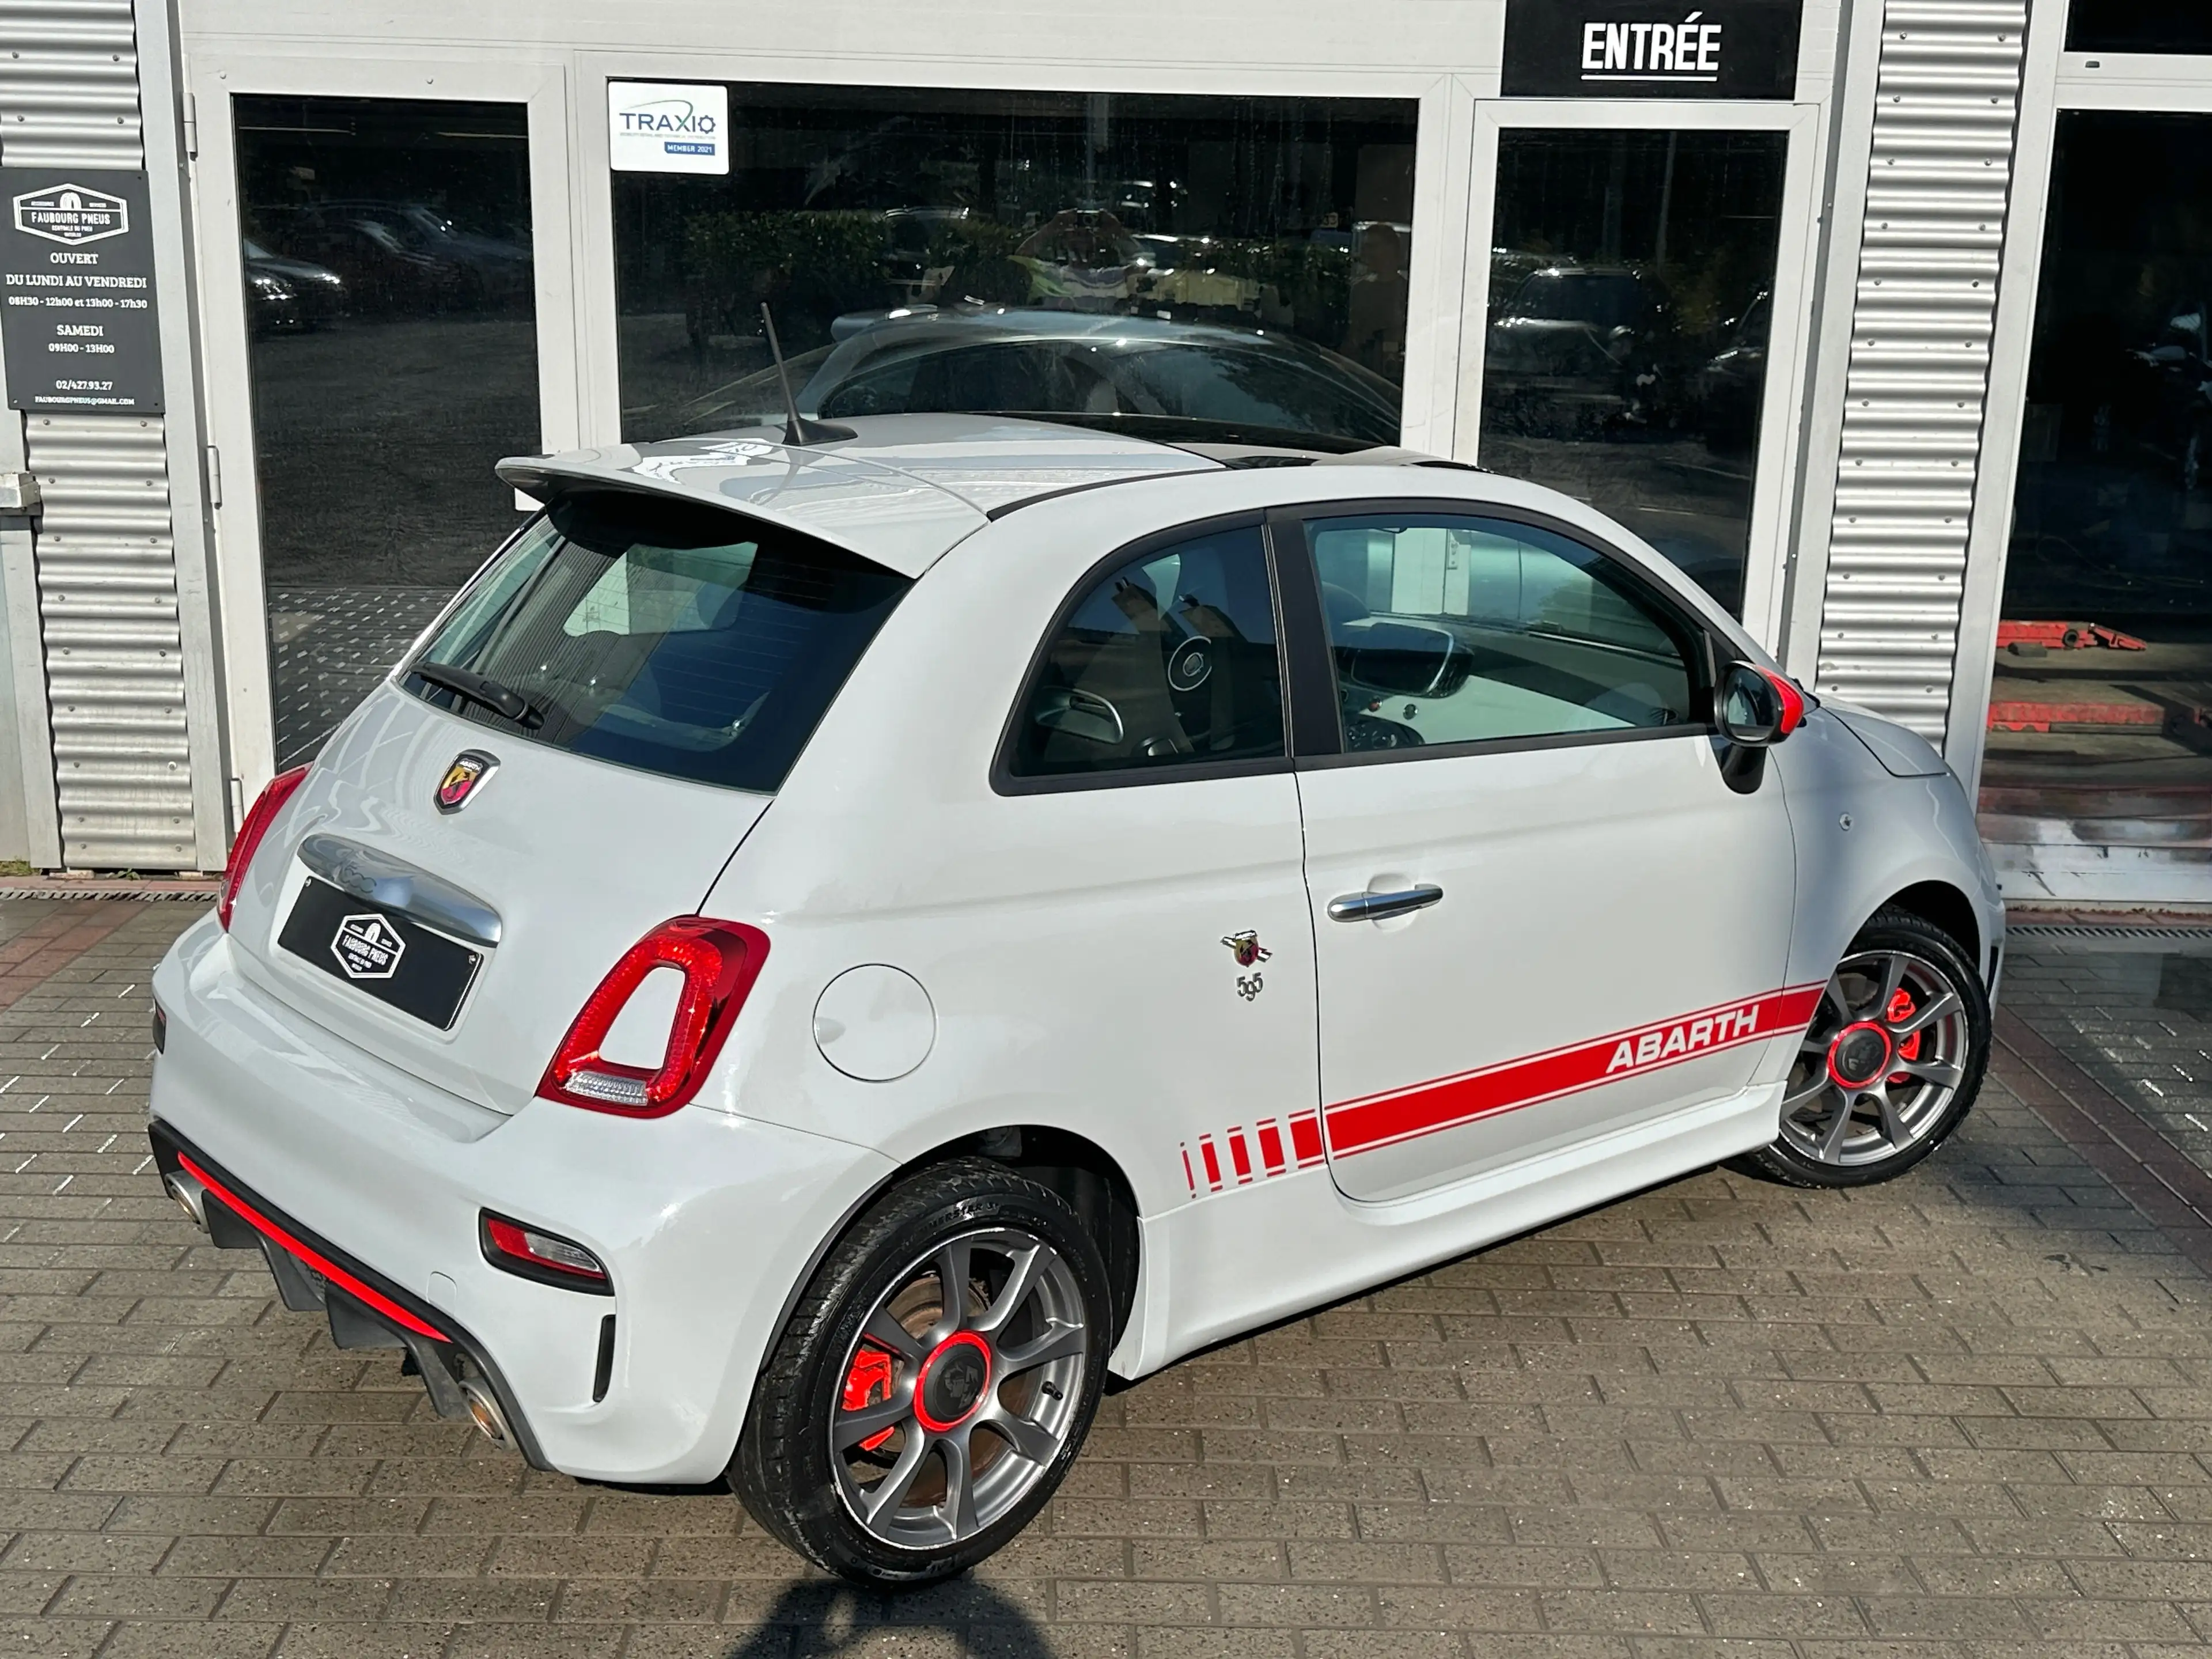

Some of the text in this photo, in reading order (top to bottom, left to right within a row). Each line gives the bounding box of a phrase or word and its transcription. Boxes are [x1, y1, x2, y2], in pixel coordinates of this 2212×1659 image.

[1582, 11, 1722, 70] ENTRÉE
[619, 112, 716, 134] TRAXIO
[31, 212, 111, 225] FAUBOURG PNEUS
[50, 252, 99, 264] OUVERT
[6, 274, 147, 288] DU LUNDI AU VENDREDI
[8, 296, 39, 305] 08H30
[46, 297, 73, 306] 12h00
[74, 298, 85, 307] et
[86, 298, 113, 307] 13h00
[120, 299, 147, 308] 17h30
[56, 324, 104, 336] SAMEDI
[48, 343, 79, 353] 09H00
[85, 344, 115, 353] 13H00
[56, 380, 113, 391] 02/427.93.27
[1236, 972, 1263, 1002] 595
[1605, 1004, 1759, 1074] ABARTH
